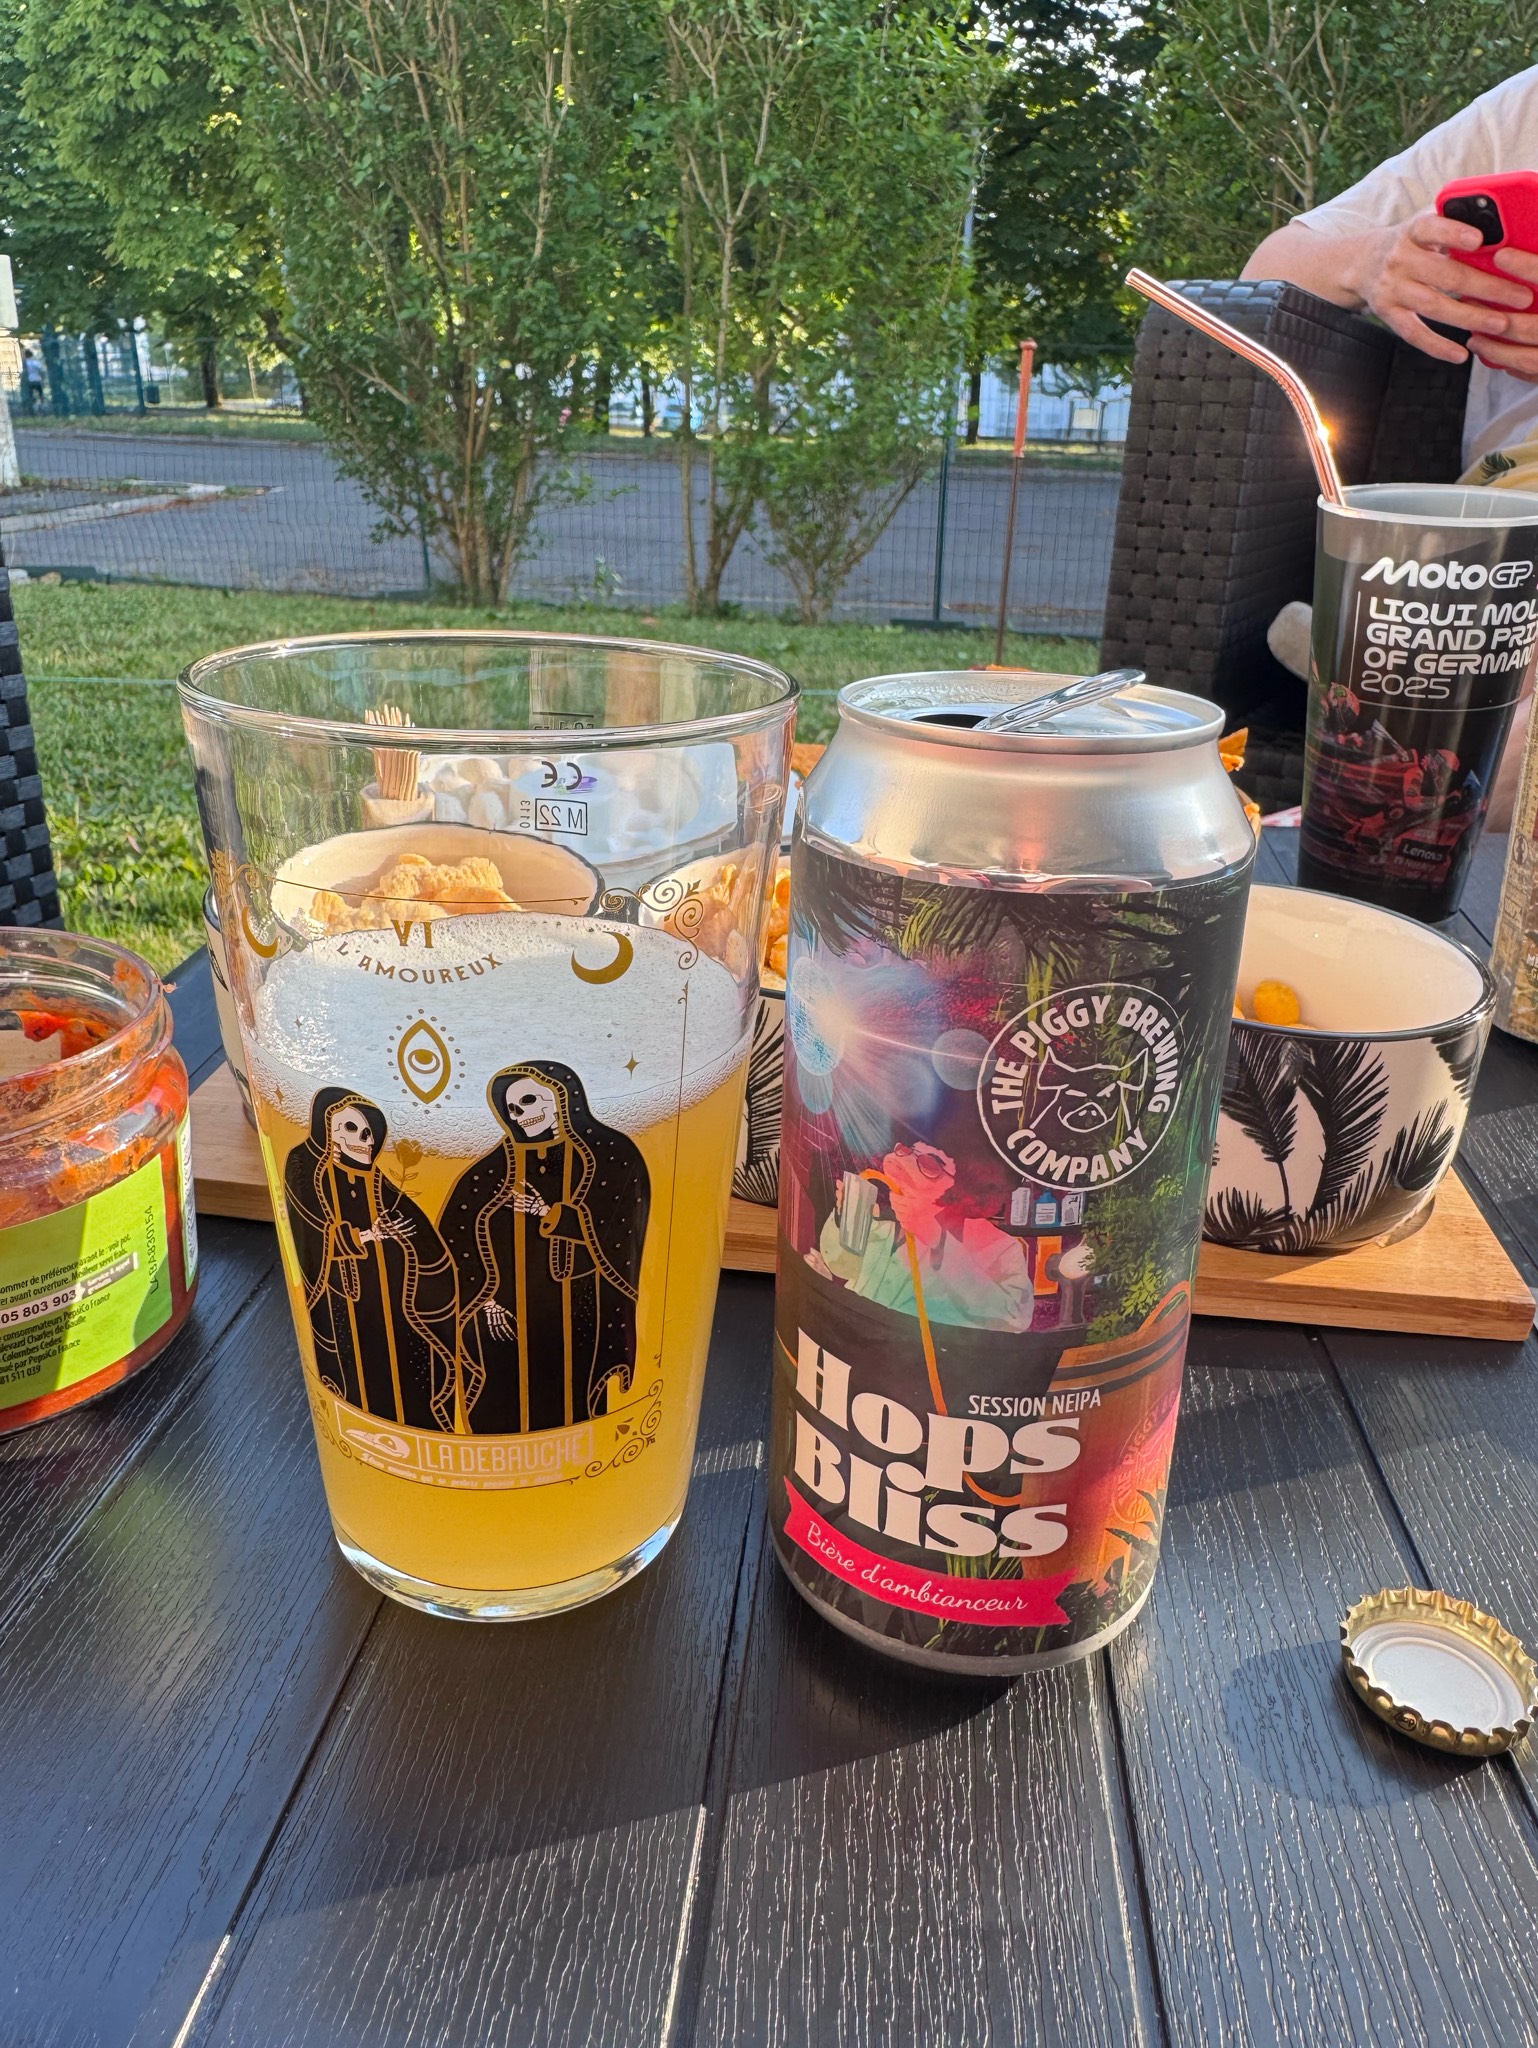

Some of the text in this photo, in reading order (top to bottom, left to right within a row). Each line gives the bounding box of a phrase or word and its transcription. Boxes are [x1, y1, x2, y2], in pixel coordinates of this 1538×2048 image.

[1369, 597, 1538, 626] LIQUI MOL
[1366, 623, 1486, 650] GRAND
[1364, 643, 1535, 675] OF GERMAN
[1361, 670, 1451, 699] 2025
[391, 919, 434, 948] VI
[991, 995, 1178, 1114] THE PIGGY BREWING
[1007, 1127, 1148, 1183] COMPANY
[0, 1279, 28, 1294] ommer
[23, 1301, 48, 1317] 803
[53, 1290, 76, 1307] 903
[796, 1327, 1081, 1493] Hops
[968, 1389, 1101, 1417] SESSION NEIPA
[425, 1441, 453, 1470] LA
[460, 1430, 583, 1473] DEBAUCHE
[794, 1410, 1069, 1558] Bliss
[807, 1521, 1028, 1612] Bière d'ambianceur
